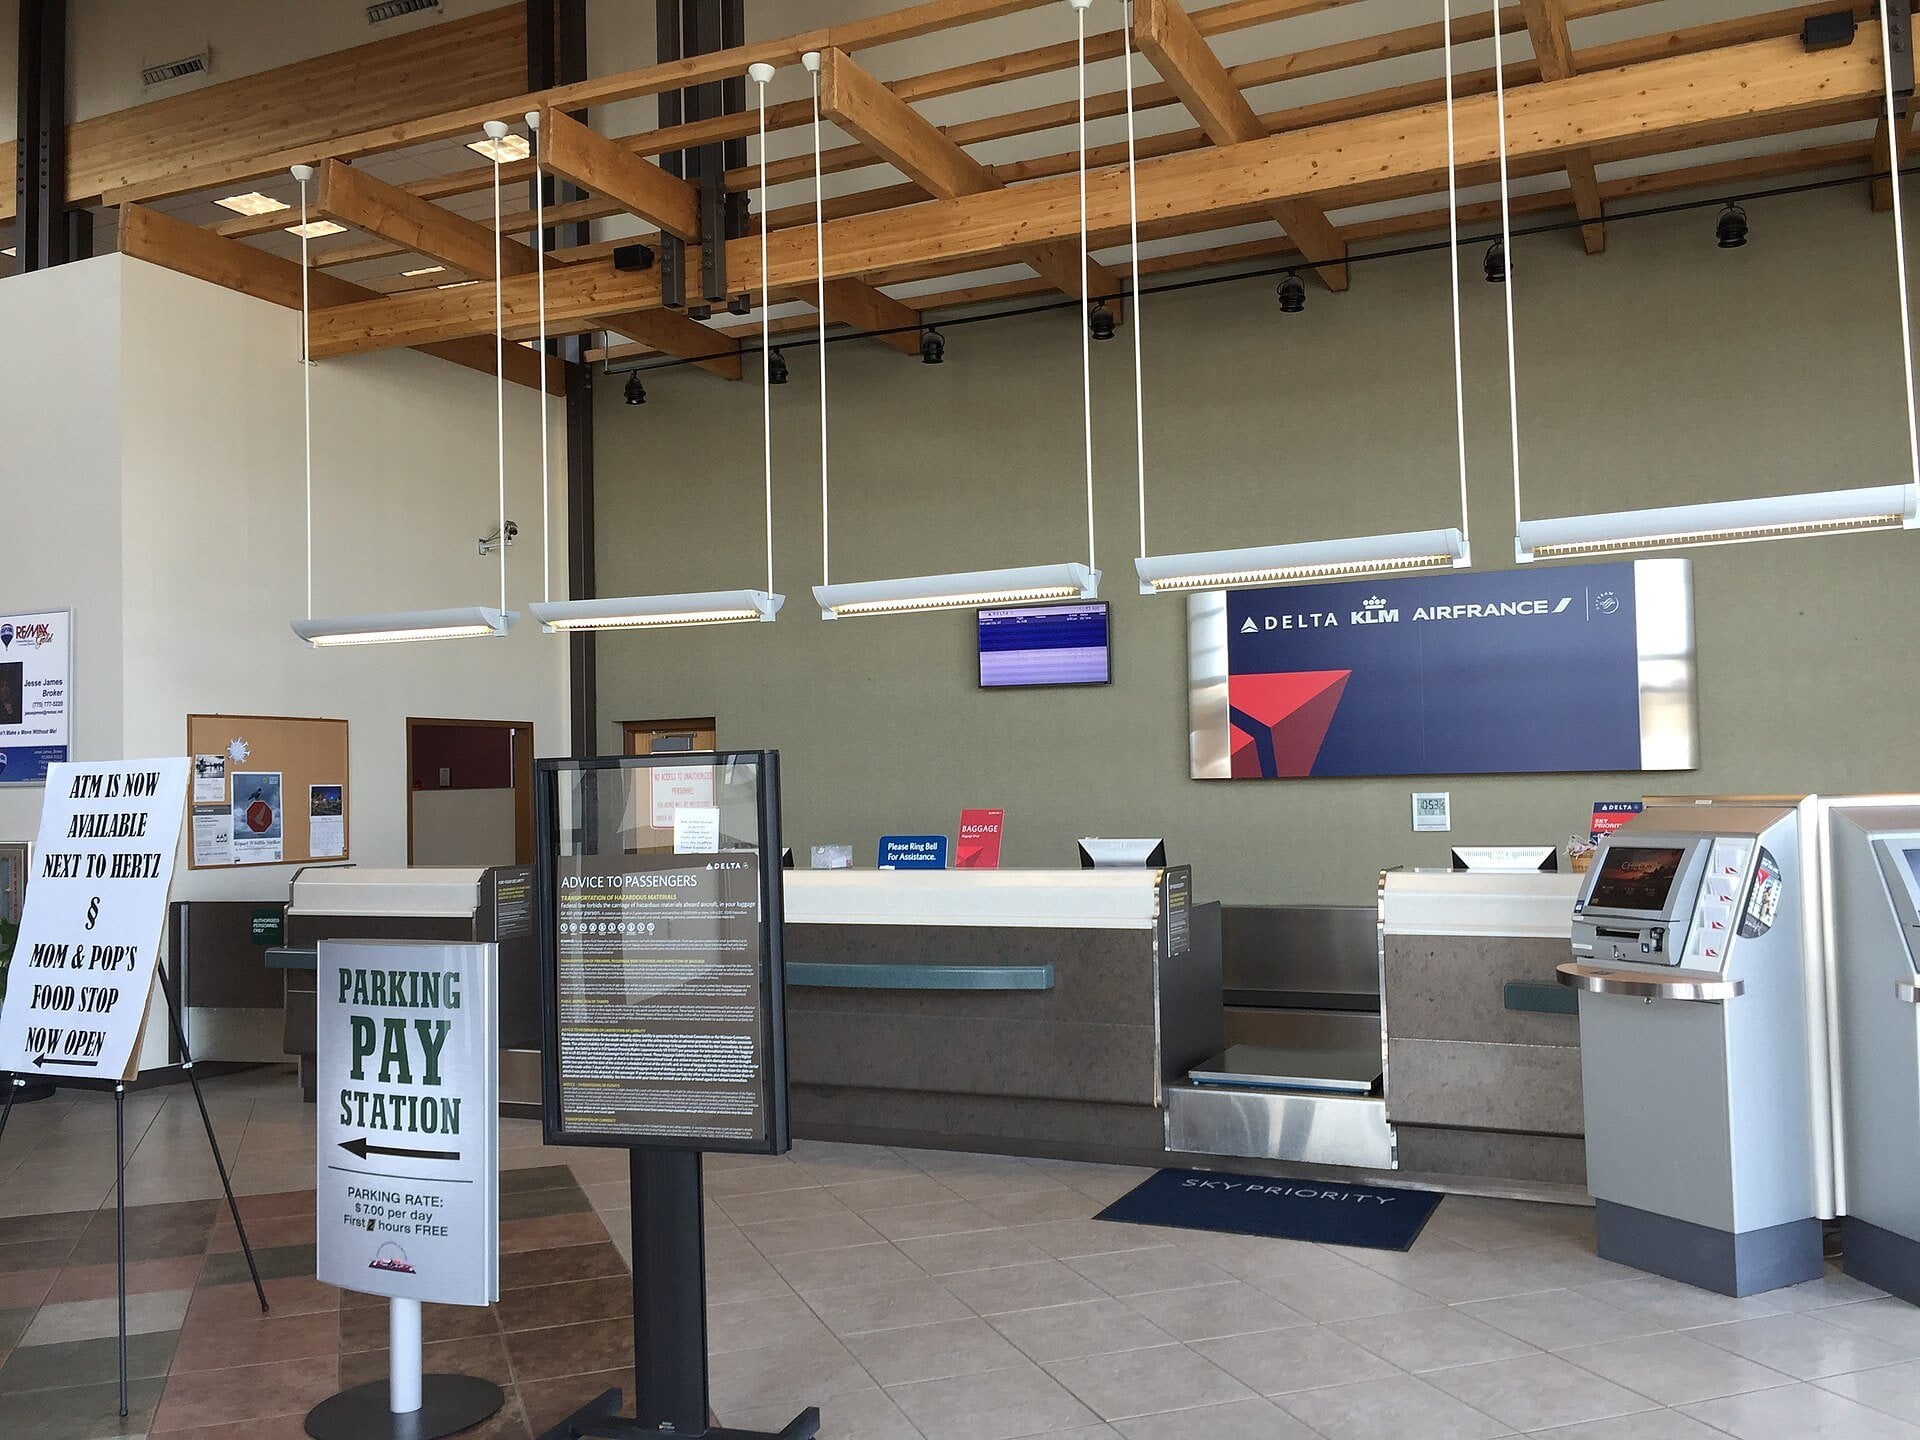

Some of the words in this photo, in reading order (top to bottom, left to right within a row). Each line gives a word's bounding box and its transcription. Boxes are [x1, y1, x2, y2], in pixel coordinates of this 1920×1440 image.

[1264, 612, 1338, 630] DELTA
[1350, 608, 1399, 625] KLM
[1412, 599, 1548, 621] AIRFRANCE
[16, 623, 49, 639] RE/MAX
[42, 689, 63, 697] Broker
[69, 774, 104, 798] ATM
[104, 774, 121, 798] IS
[122, 772, 160, 797] NOW
[67, 812, 148, 838] AVAILABLE
[962, 824, 998, 832] BAGGAGE
[888, 842, 909, 850] Please
[910, 842, 924, 852] Ring
[42, 854, 82, 878] NEXT
[86, 854, 106, 878] TO
[110, 854, 161, 878] HERTZ
[561, 876, 604, 888] ADVICE
[607, 876, 622, 888] TO
[625, 874, 698, 888] PASSENGERS
[29, 944, 69, 968] MOM
[71, 944, 86, 970] &
[88, 945, 138, 972] POP'S
[30, 984, 74, 1010] FOOD
[78, 986, 119, 1013] STOP
[338, 968, 460, 1010] PARKING
[25, 1027, 63, 1054] NOW
[64, 1030, 106, 1057] OPEN
[350, 1015, 450, 1086] PAY
[340, 1088, 462, 1134] STATION
[348, 1186, 400, 1204] PARKING
[405, 1194, 444, 1208] RATE:
[344, 1214, 366, 1228] First
[366, 1218, 376, 1232] 2
[378, 1220, 410, 1234] hours
[415, 1224, 448, 1236] FREE
[388, 1206, 406, 1219] per
[410, 1210, 433, 1224] day
